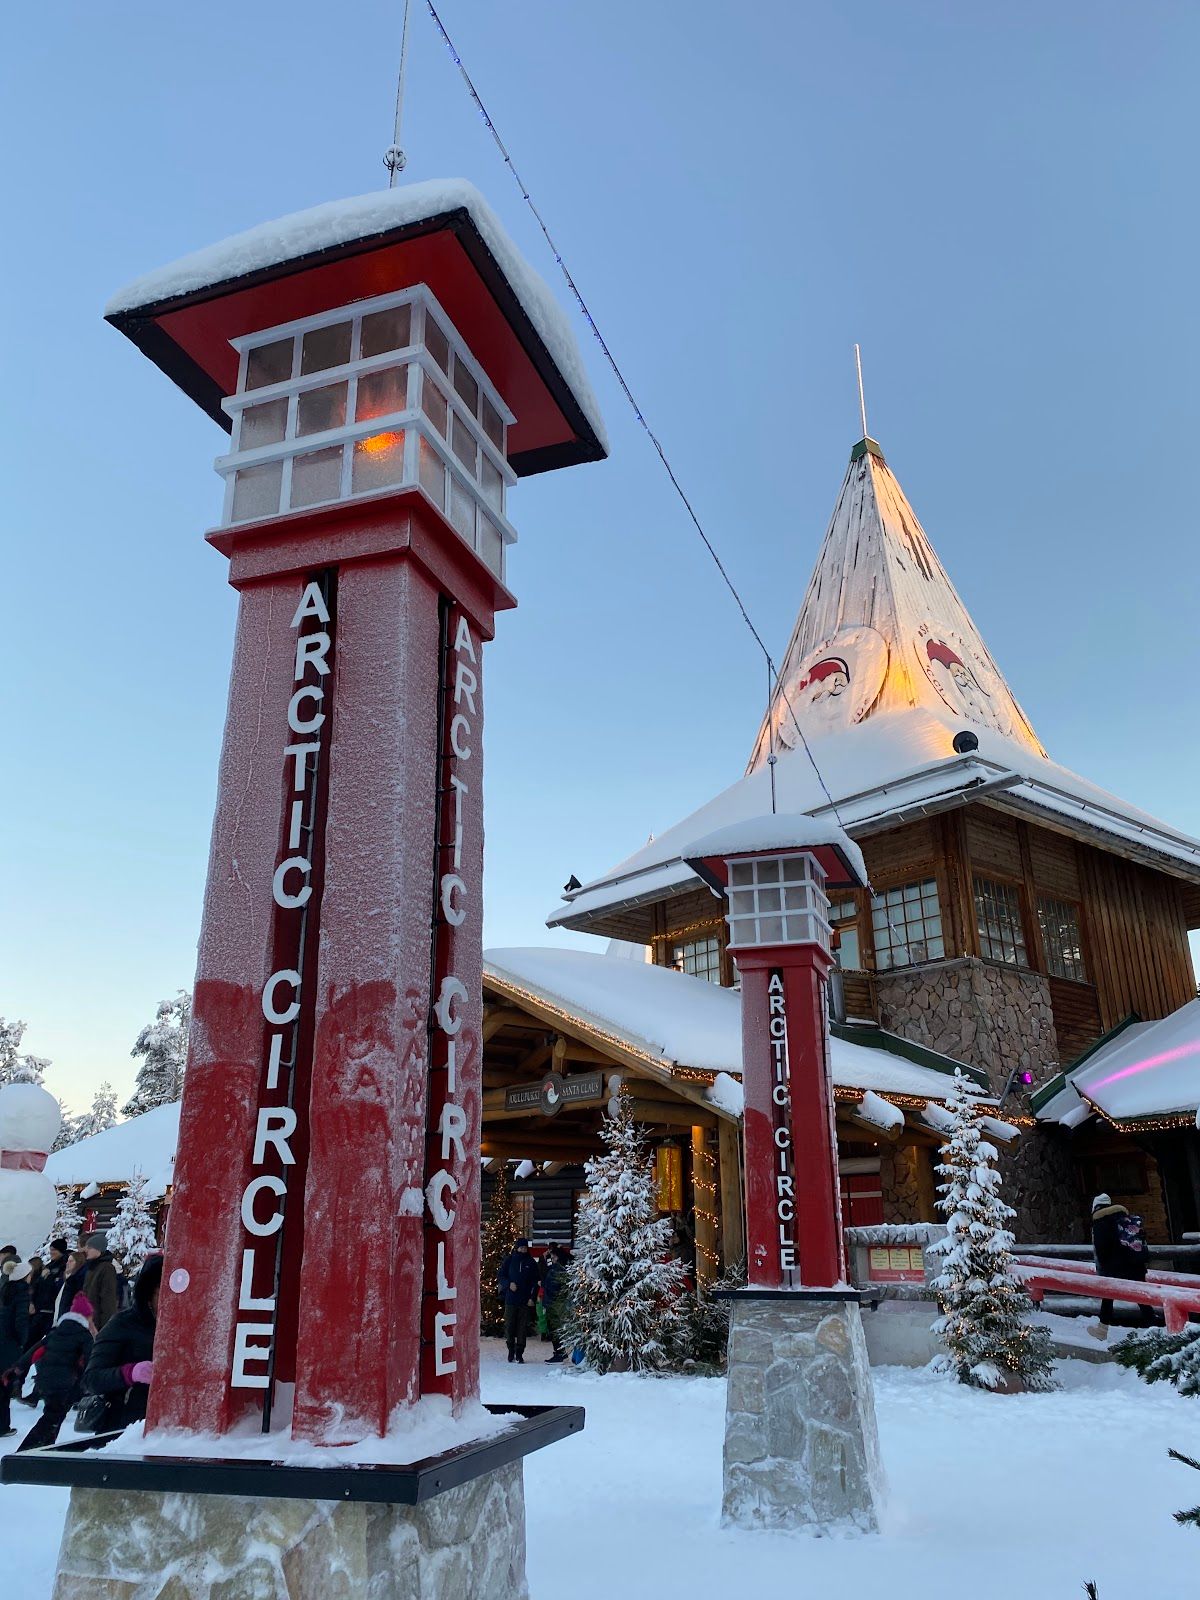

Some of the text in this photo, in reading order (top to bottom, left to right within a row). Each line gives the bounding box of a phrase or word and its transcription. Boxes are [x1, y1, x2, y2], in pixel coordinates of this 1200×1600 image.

[231, 581, 331, 1389] ARCTIC CIRCLE
[427, 615, 478, 1377] ARCTIC CIRCLE
[562, 1082, 599, 1097] SANTA CLAUS
[768, 974, 796, 1270] ARCTIC CIRCLE
